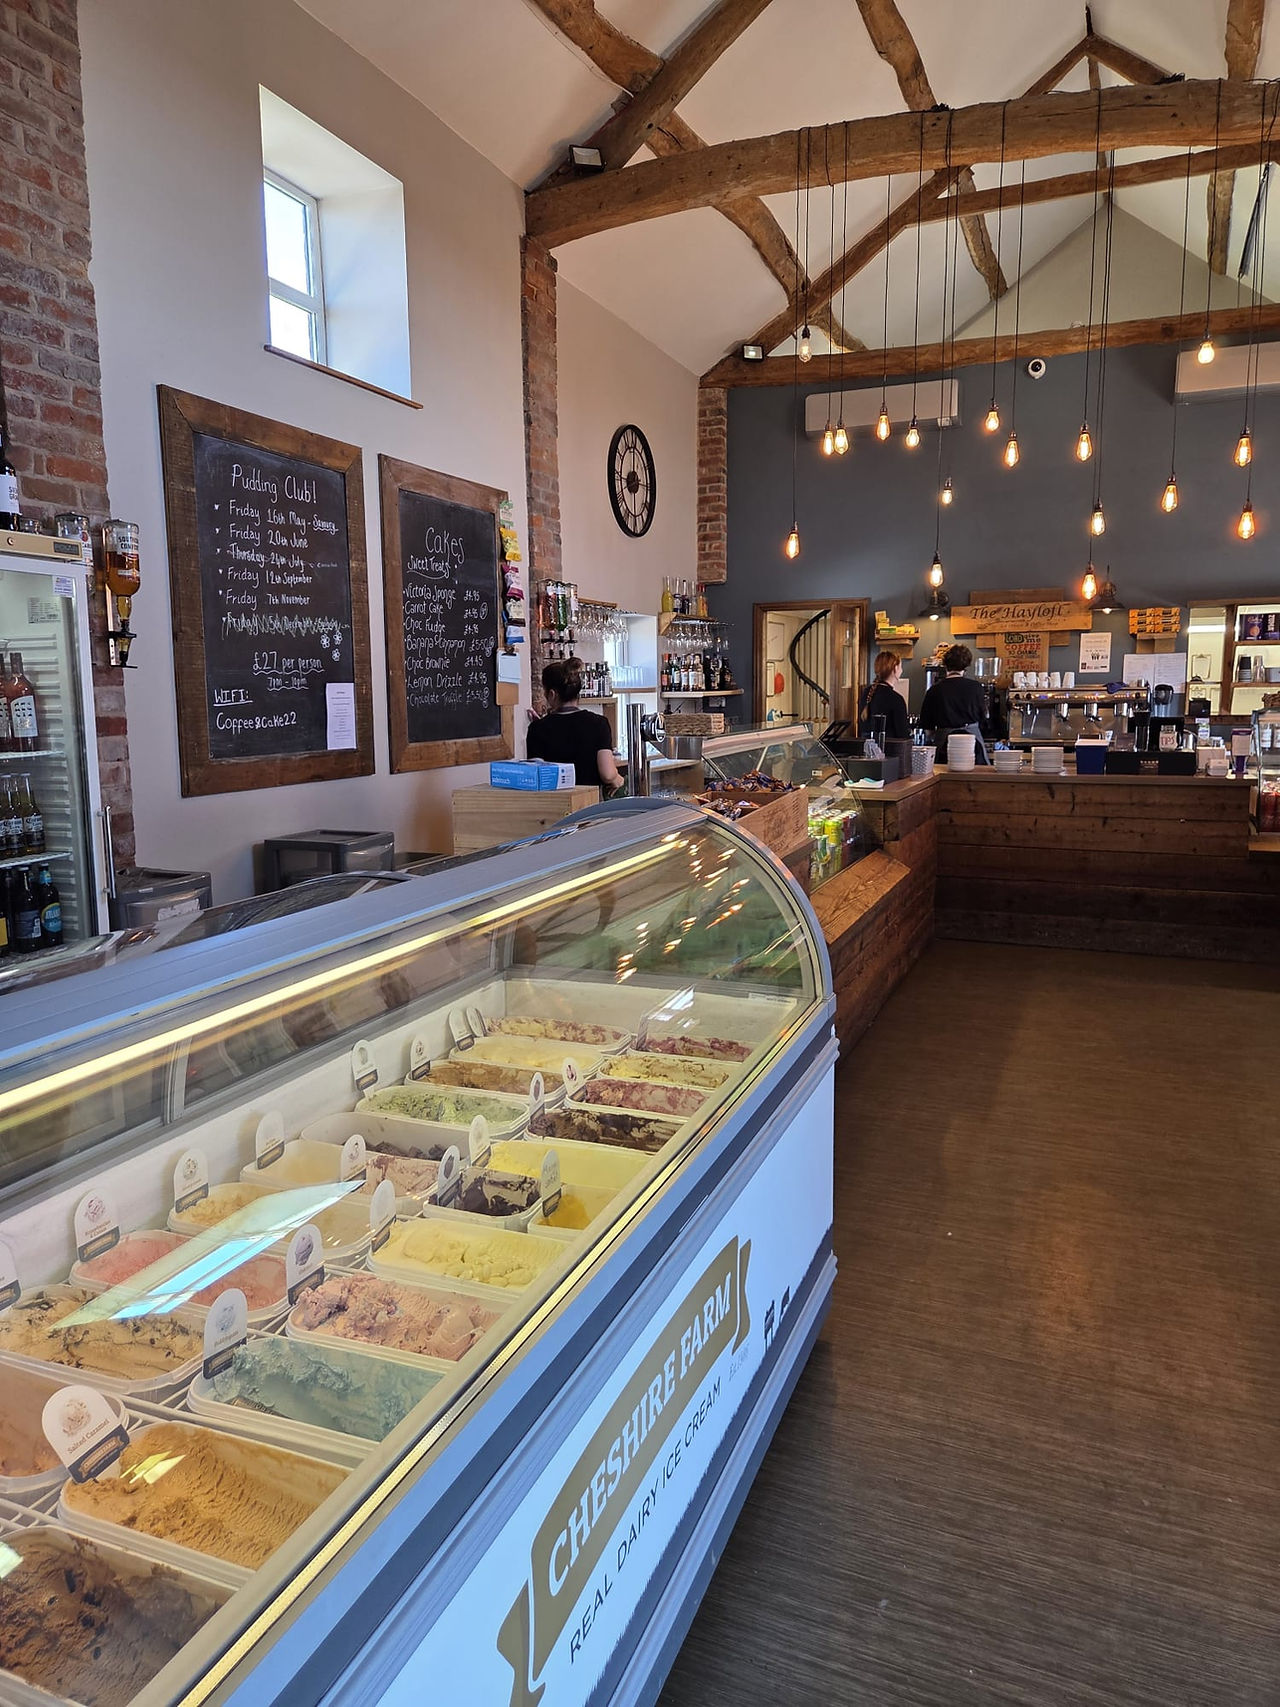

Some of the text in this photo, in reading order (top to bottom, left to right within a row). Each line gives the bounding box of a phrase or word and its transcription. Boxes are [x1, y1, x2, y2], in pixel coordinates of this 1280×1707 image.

[231, 464, 317, 503] Pudding Club!
[229, 500, 260, 526] Friday
[267, 508, 286, 525] 16th
[289, 511, 307, 536] May
[229, 523, 309, 548] Friday 20th June
[229, 542, 265, 568] Thursday
[288, 554, 305, 573] July
[407, 555, 451, 579] Sweet Treats
[227, 567, 313, 589] Friday 12th September
[226, 588, 310, 611] Friday 7th November
[405, 583, 432, 600] Victoria
[432, 585, 456, 609] Sponge
[404, 600, 427, 614] Carrot
[428, 602, 444, 621] Cake
[970, 602, 1070, 620] The Hayloft
[405, 616, 423, 634] Choc
[425, 615, 446, 640] Fudge
[406, 634, 434, 658] Banana
[439, 638, 466, 658] Cinnamon
[1004, 643, 1041, 651] COFFEE
[252, 651, 322, 678] £27 per person
[407, 656, 424, 675] Choc
[425, 656, 450, 669] Brownie
[407, 676, 433, 691] Lemon
[436, 672, 462, 689] Drizzle
[214, 689, 249, 703] WIFI:
[67, 1436, 87, 1454] Salted
[549, 1271, 732, 1597] CHESHIRE FARM
[570, 1376, 722, 1664] REAL DAIRY ICE CREAM
